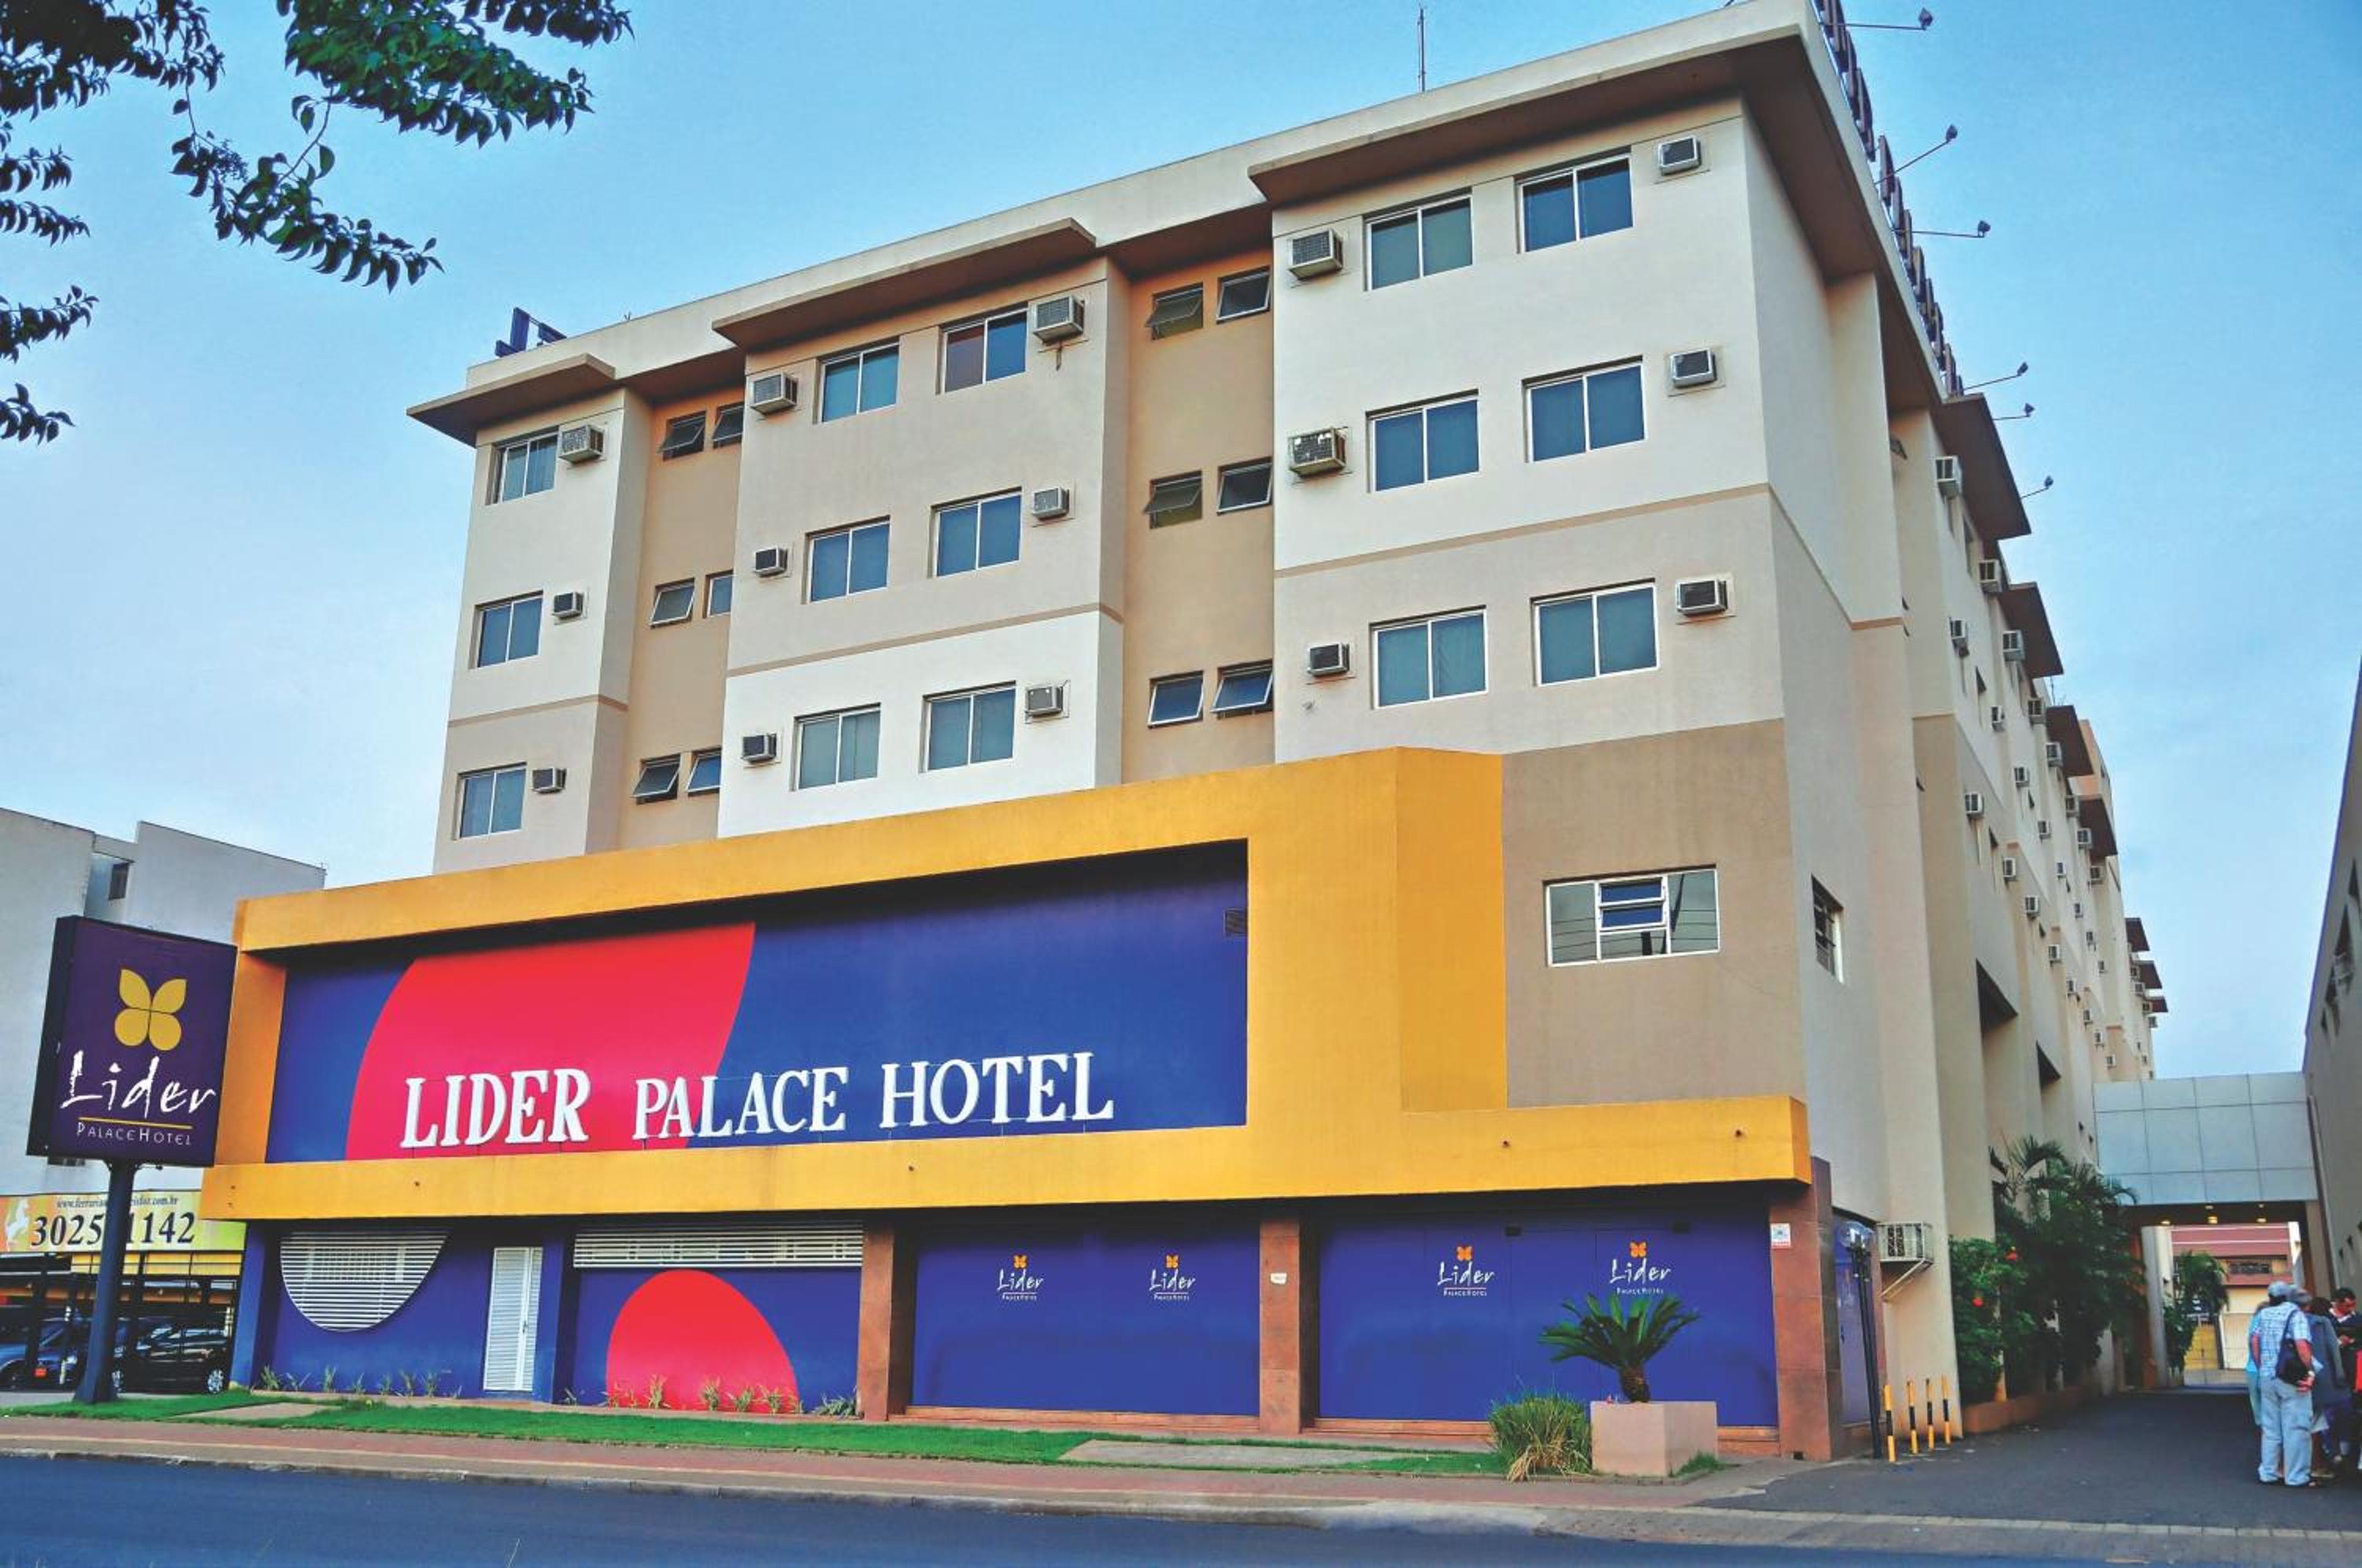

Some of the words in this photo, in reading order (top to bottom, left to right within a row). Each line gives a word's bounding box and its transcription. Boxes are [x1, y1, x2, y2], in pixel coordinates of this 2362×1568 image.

[60, 1049, 217, 1119] Lider
[400, 1068, 591, 1148] LIDER
[632, 1067, 849, 1140] PALACE
[879, 1052, 1114, 1128] HOTEL
[31, 1214, 106, 1246] 3025
[996, 1268, 1044, 1292] Lider
[1149, 1268, 1196, 1292] Lider
[1437, 1260, 1495, 1286] Lider
[1609, 1257, 1672, 1285] Lider
